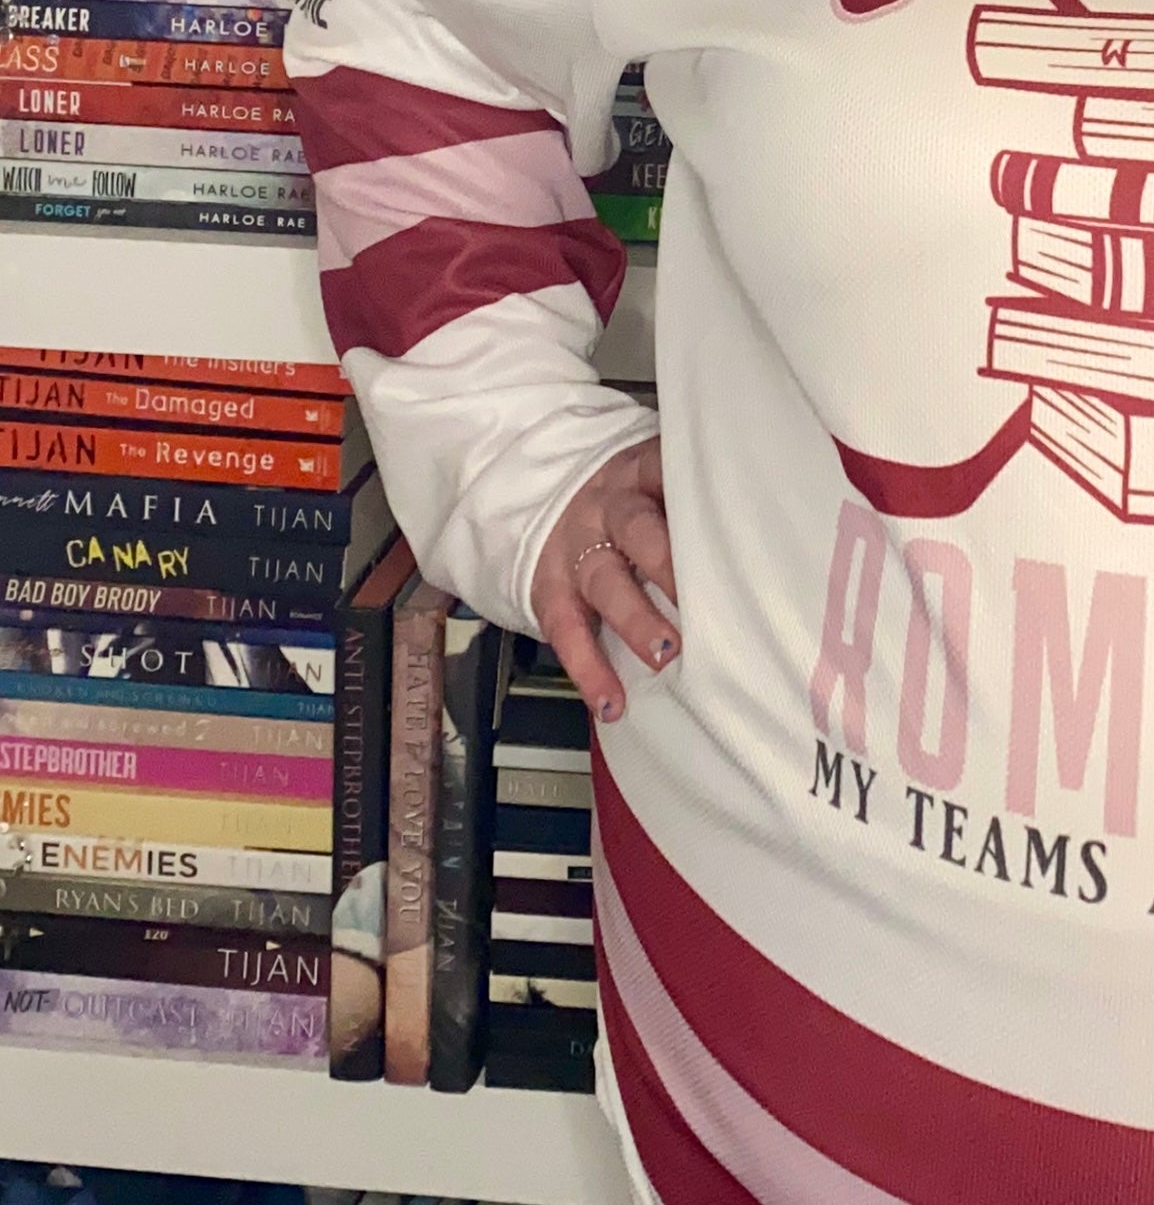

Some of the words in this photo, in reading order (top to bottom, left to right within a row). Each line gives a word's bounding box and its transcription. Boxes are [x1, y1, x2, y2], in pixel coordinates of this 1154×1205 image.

[8, 5, 90, 32] BREAKER
[171, 18, 269, 37] HARLOE
[184, 59, 271, 75] HARLOE
[19, 88, 81, 115] LONER
[182, 103, 262, 121] HARLOE
[19, 129, 85, 156] LONER
[181, 144, 260, 161] HARLOE
[2, 167, 42, 193] WATCH
[91, 169, 137, 197] FOLLOW
[193, 183, 268, 200] HARLOE
[35, 203, 92, 217] FORGET
[199, 211, 265, 226] HARLOE
[277, 215, 305, 228] RAE
[135, 388, 255, 421] Damaged
[155, 442, 275, 475] Revenge
[64, 490, 217, 525] MAFIA
[253, 504, 333, 532] TIJAN
[66, 536, 190, 579] CANARY
[249, 556, 323, 584] TIJAN
[6, 579, 45, 603] BAD
[50, 582, 90, 607] BOY
[93, 585, 161, 613] BRODY
[206, 597, 277, 621] TIJAN
[79, 645, 193, 675] SHOT
[344, 631, 364, 696] ANTI
[406, 650, 429, 731] HATE
[0, 744, 137, 779] STEPBROTHER
[402, 766, 425, 848] LOVE
[810, 739, 876, 826] MY
[906, 788, 1108, 906] TEAMS
[41, 843, 198, 877] ENEMIES
[56, 889, 139, 913] RYAN'S
[151, 897, 199, 919] BED
[400, 863, 423, 925] YOU
[217, 949, 319, 987] TIJAN
[62, 994, 199, 1027] OUTCAST
